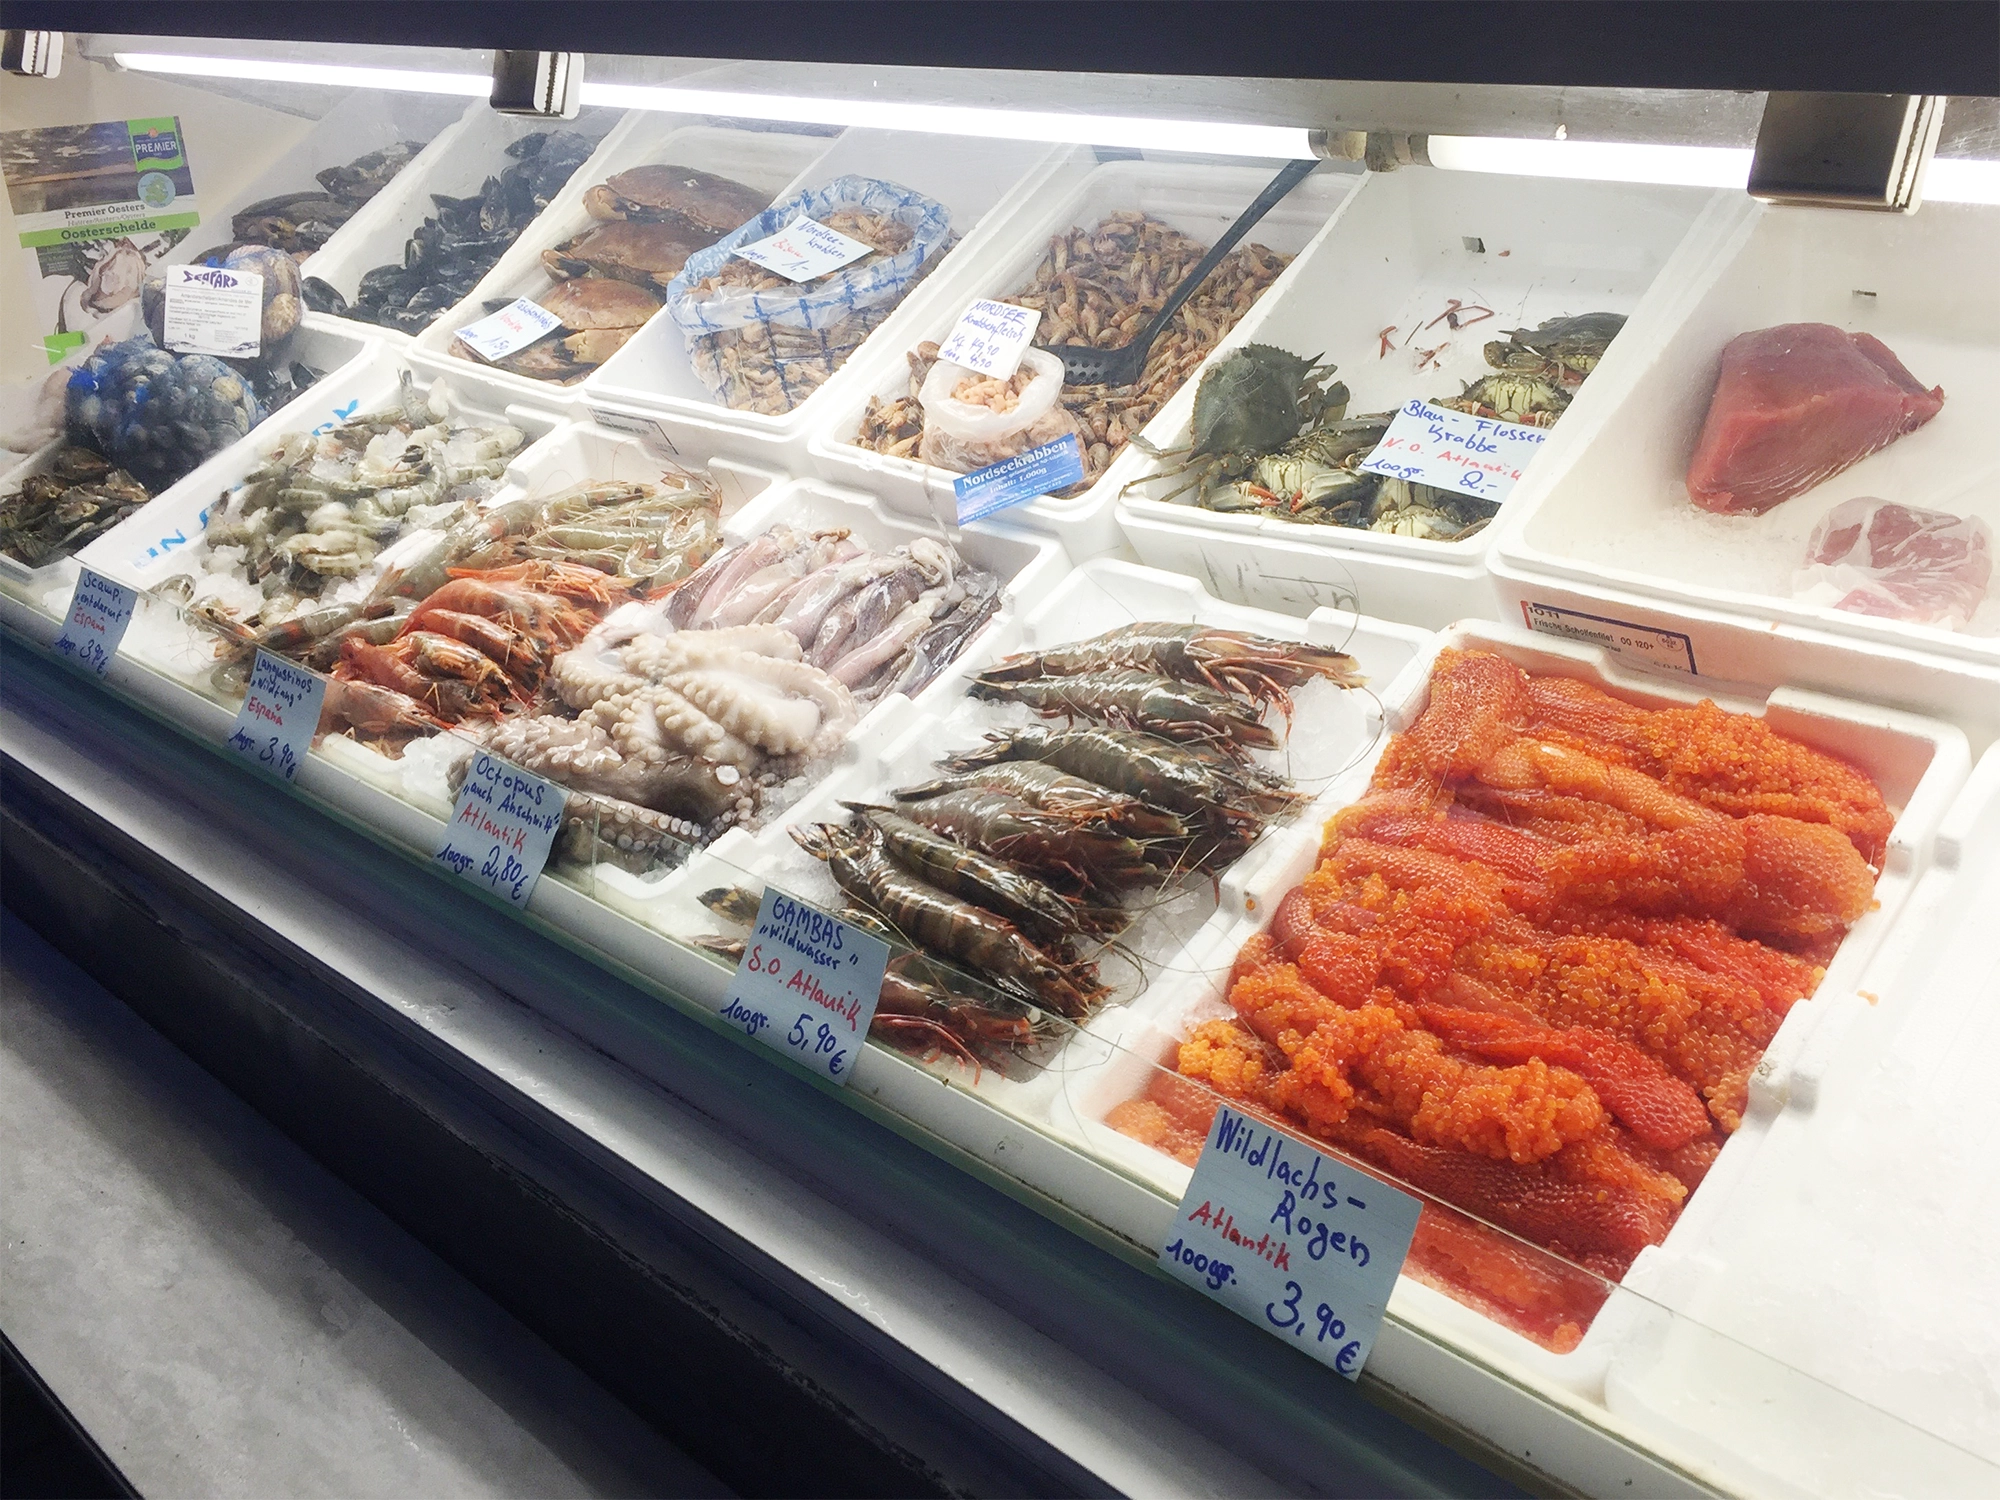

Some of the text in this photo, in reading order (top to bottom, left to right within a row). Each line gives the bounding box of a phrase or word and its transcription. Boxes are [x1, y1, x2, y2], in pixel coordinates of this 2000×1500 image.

[135, 140, 178, 154] PREMIER
[61, 220, 156, 240] Oosterschelde
[64, 203, 146, 219] Premier Oesters
[970, 301, 1028, 326] NORDSEE
[1428, 424, 1498, 454] Krabbe
[962, 441, 1068, 488] Nordseekrabben
[989, 478, 1017, 494] Inhalt:
[1019, 467, 1047, 482] 1.000g
[84, 572, 123, 604] Scampi
[1533, 618, 1562, 632] Frische
[476, 756, 545, 806] Octopus
[457, 801, 528, 855] Atlantik
[772, 895, 844, 950] GAMBAS
[786, 969, 862, 1032] Atlantik
[1215, 1110, 1367, 1210] Wildlachs-
[1188, 1200, 1291, 1272] Atlantik
[1270, 1189, 1371, 1268] Rogen
